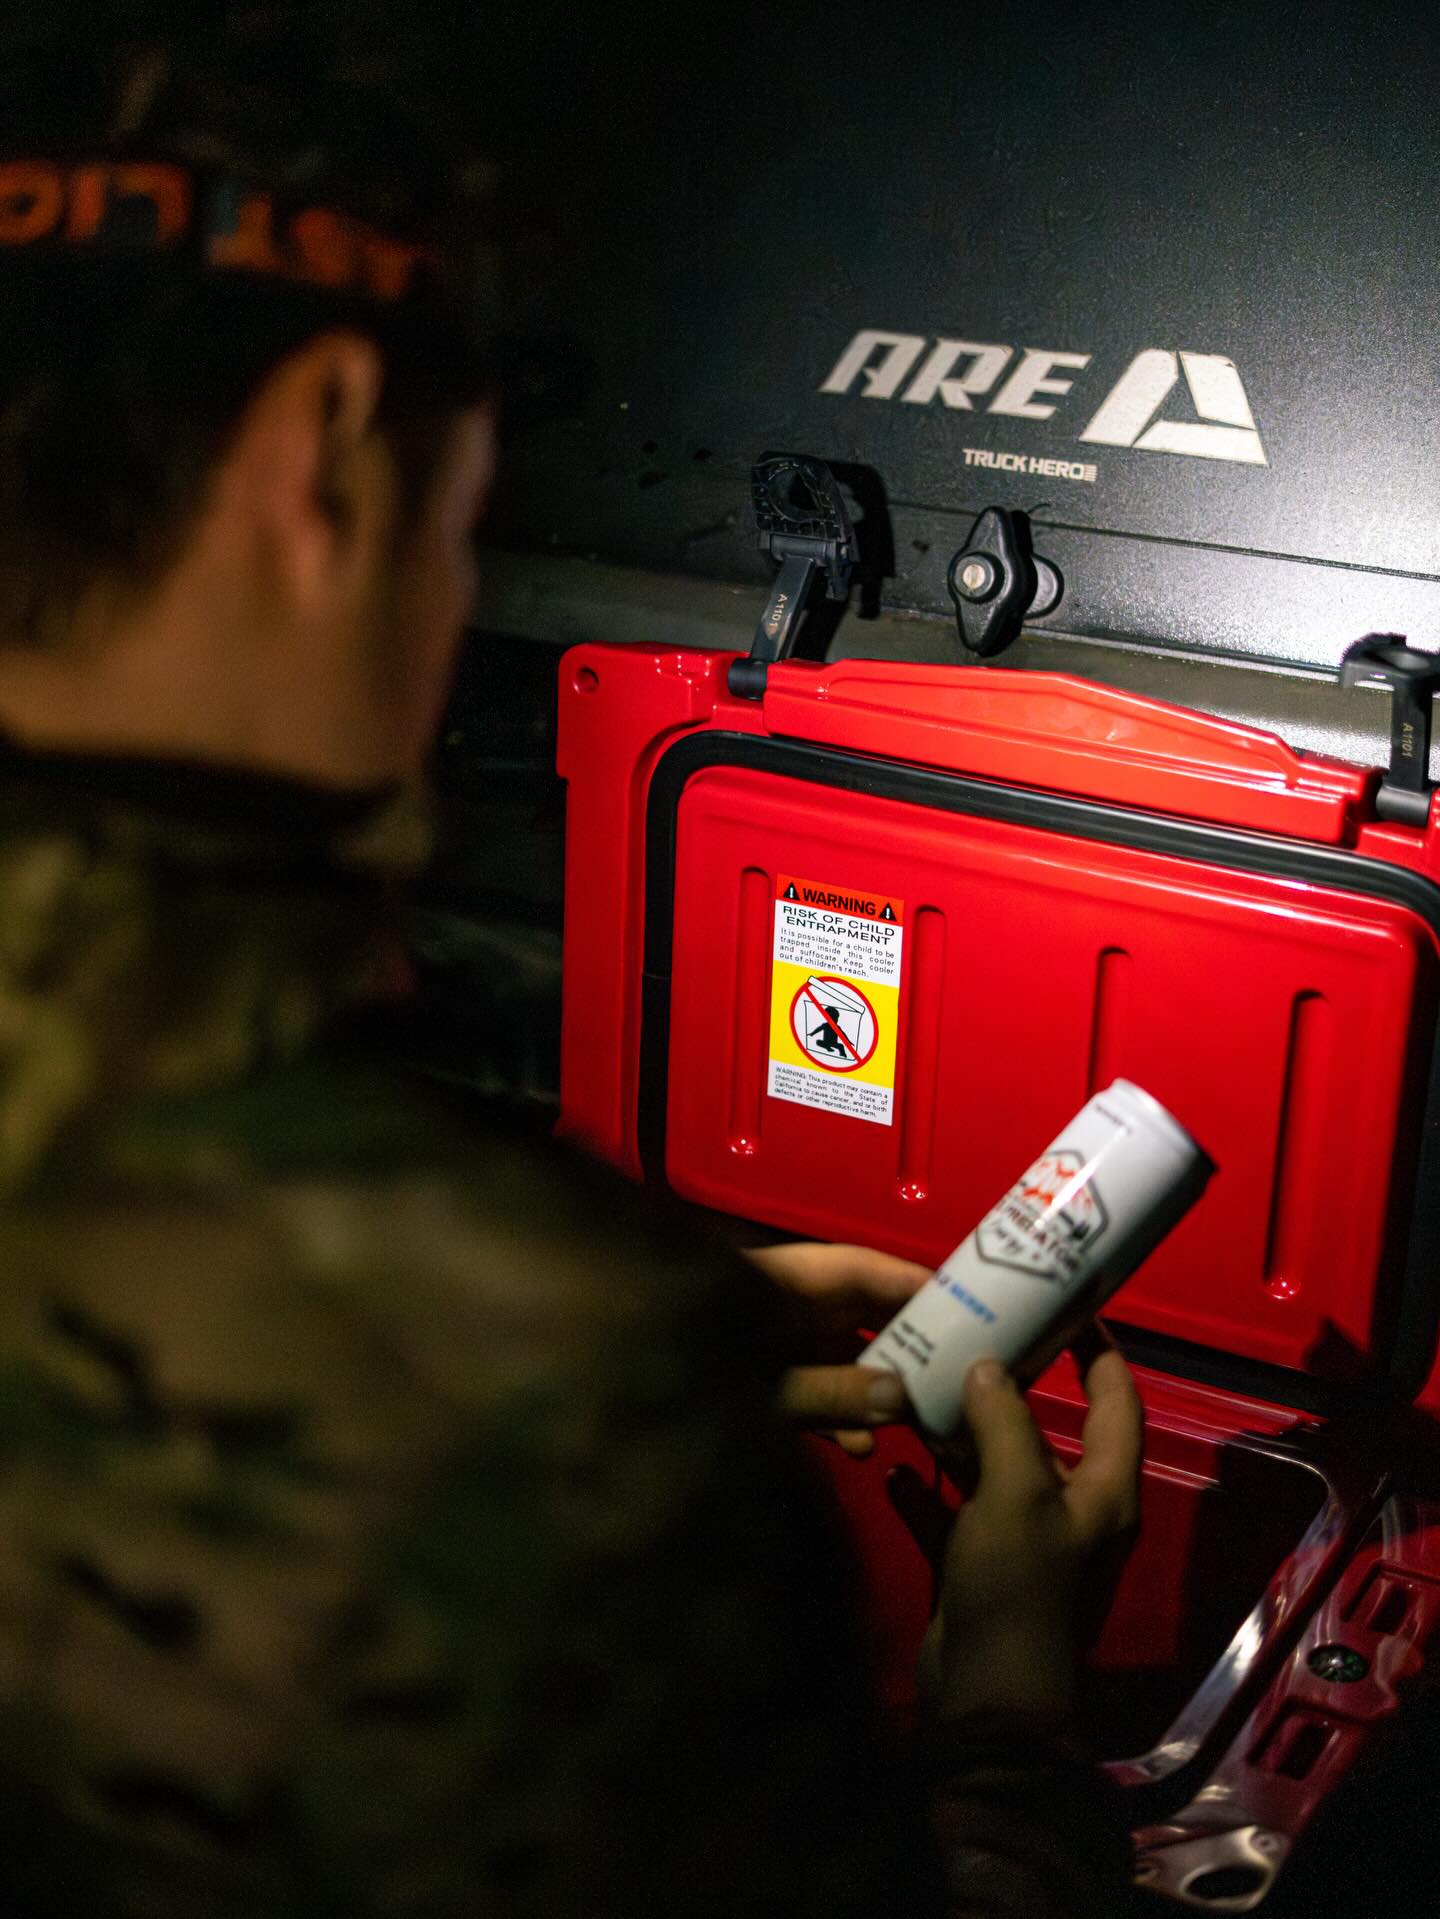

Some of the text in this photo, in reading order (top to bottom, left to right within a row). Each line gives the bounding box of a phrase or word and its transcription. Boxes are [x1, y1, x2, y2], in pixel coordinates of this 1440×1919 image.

[818, 329, 1093, 420] ARE
[963, 448, 1086, 480] TRUCK HERO
[1401, 722, 1414, 759] A1101
[803, 888, 876, 915] WARNING
[783, 905, 895, 937] RISK OF CHILD
[786, 916, 890, 945] ENTRAPMENT
[780, 936, 895, 966] trapped inside this cooler
[788, 929, 795, 937] is
[798, 932, 829, 944] possible
[833, 939, 843, 947] for
[854, 944, 872, 954] child
[780, 945, 894, 975] and suffocate. Keep cooler
[780, 952, 793, 961] out
[805, 957, 842, 972] children's
[860, 1094, 876, 1103] State
